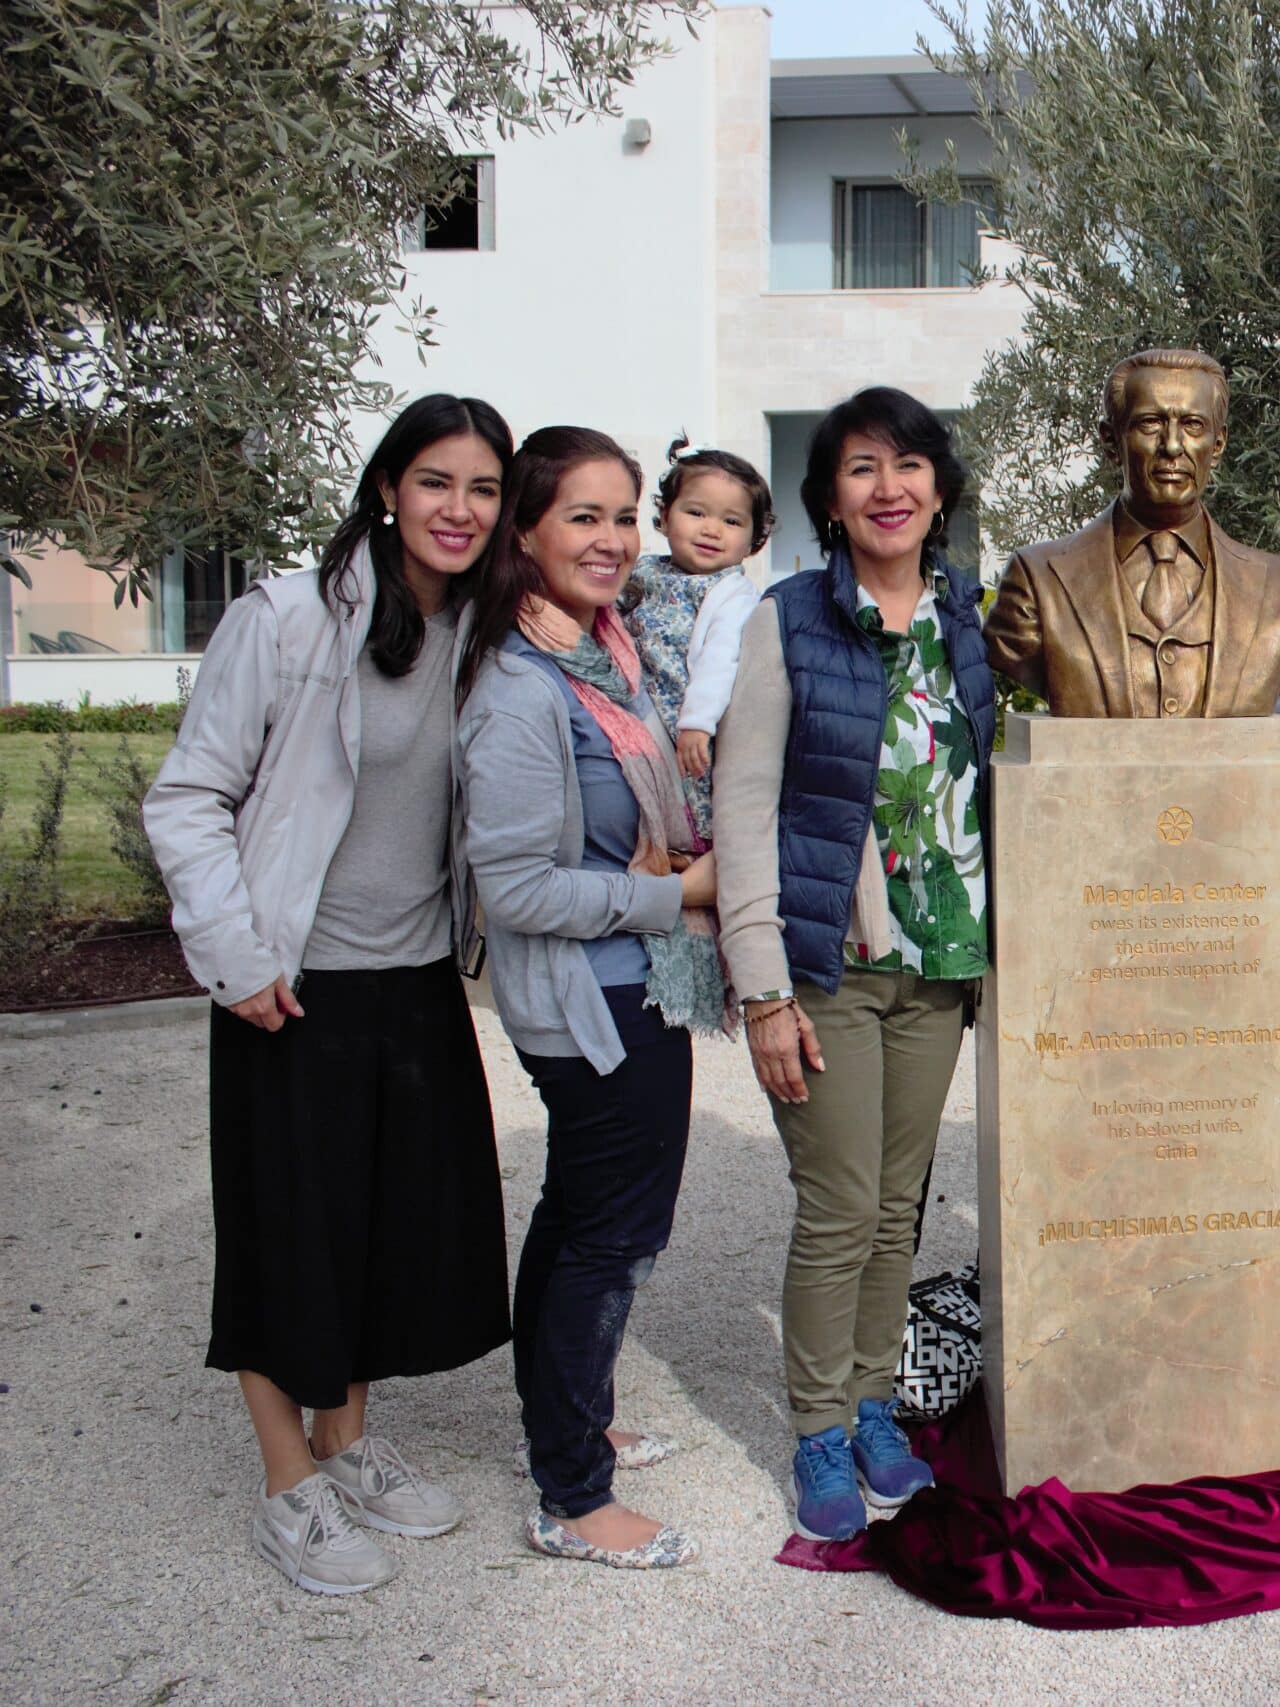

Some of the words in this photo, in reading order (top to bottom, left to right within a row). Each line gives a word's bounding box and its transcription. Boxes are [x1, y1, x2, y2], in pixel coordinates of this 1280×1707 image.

[1083, 882, 1184, 909] Magdala
[1190, 880, 1267, 900] Center
[1090, 920, 1133, 931] owes
[1139, 915, 1157, 929] its
[1162, 913, 1239, 929] existence
[1242, 913, 1260, 928] to
[1116, 939, 1143, 955] the
[1148, 935, 1200, 954] timely
[1204, 936, 1235, 953] and
[1090, 964, 1169, 983] generous
[1173, 960, 1240, 980] support
[1243, 958, 1261, 975] of
[1035, 1032, 1073, 1053] Mr.
[1079, 1027, 1188, 1051] Antonino
[1092, 1101, 1109, 1115] In
[1113, 1100, 1164, 1116] loving
[1168, 1097, 1237, 1113] memory
[1241, 1093, 1259, 1110] of
[1108, 1124, 1131, 1139] his
[1135, 1120, 1201, 1138] beloved
[1204, 1117, 1243, 1135] wife,
